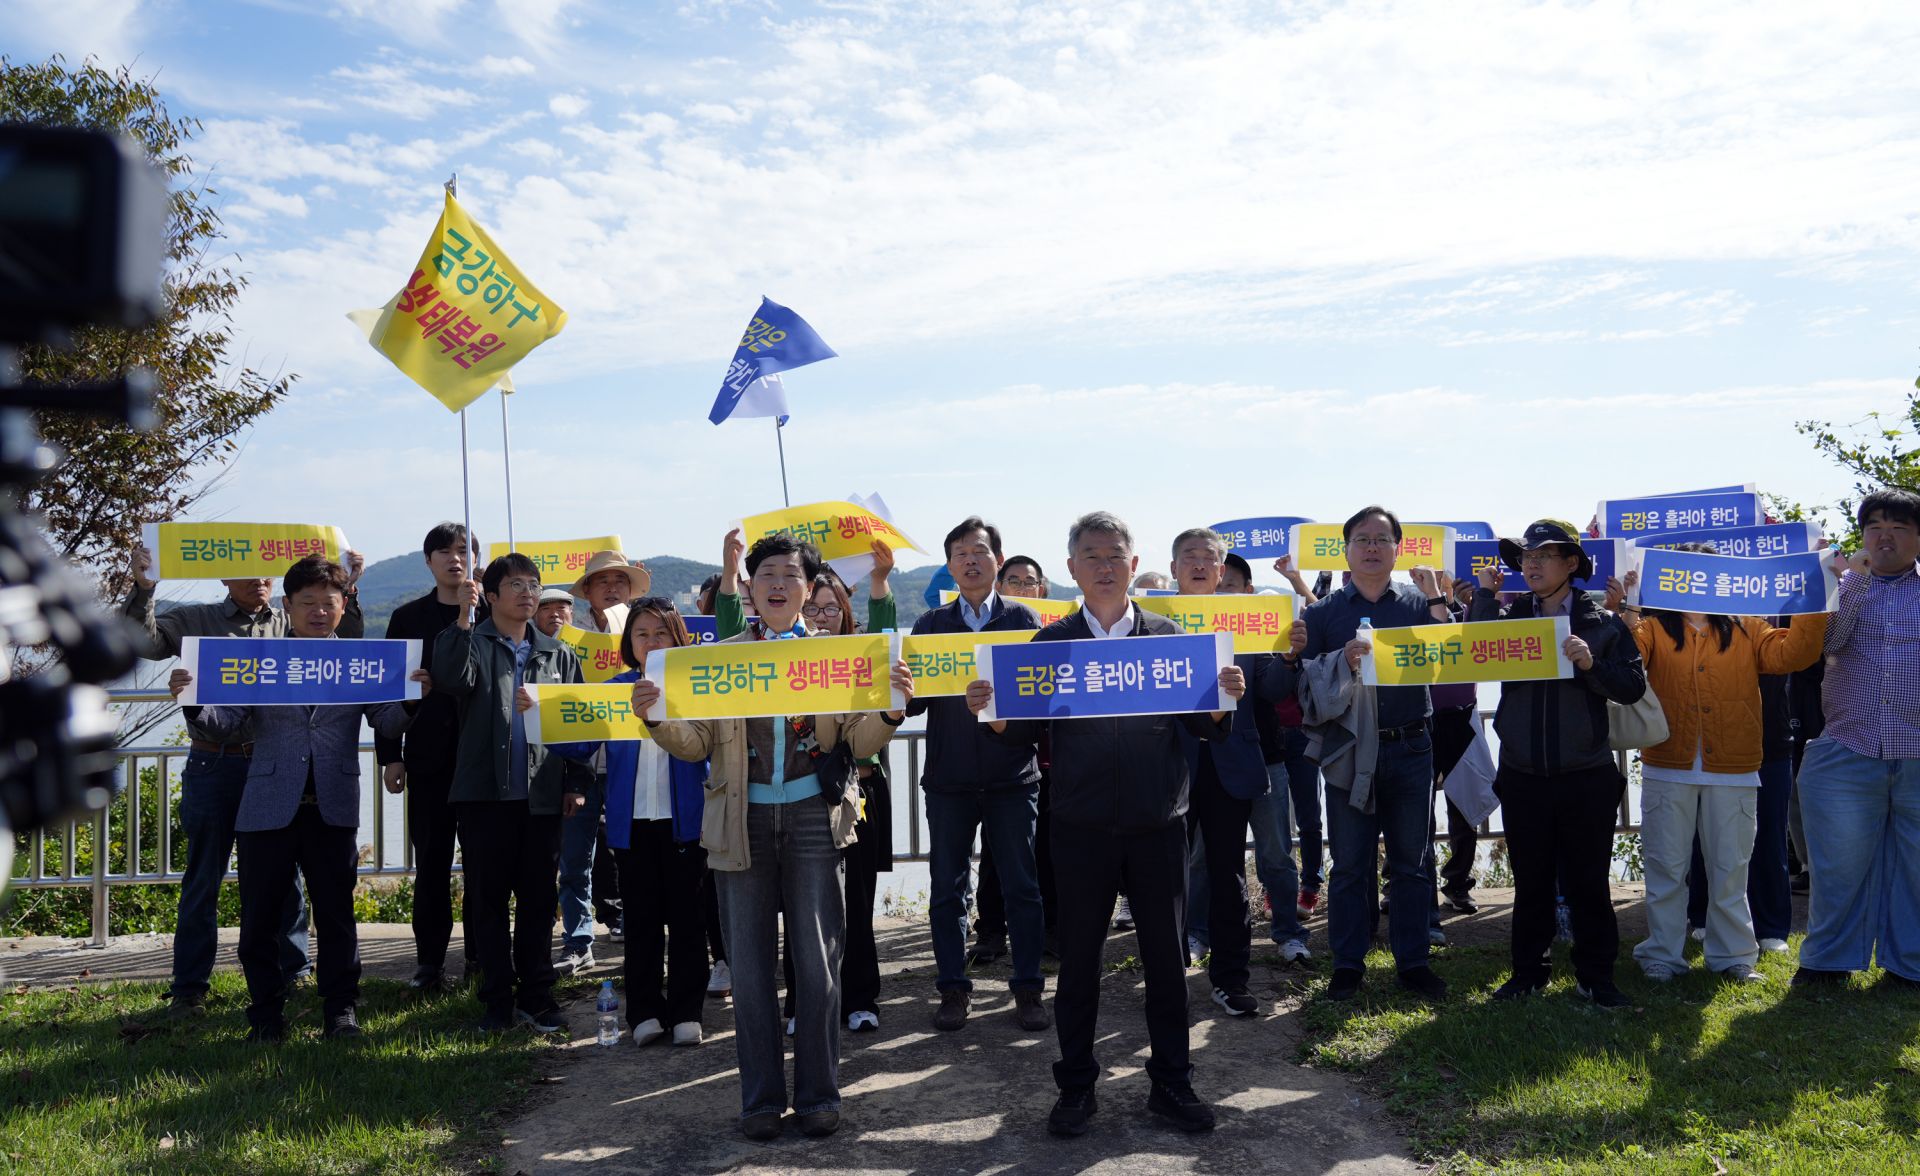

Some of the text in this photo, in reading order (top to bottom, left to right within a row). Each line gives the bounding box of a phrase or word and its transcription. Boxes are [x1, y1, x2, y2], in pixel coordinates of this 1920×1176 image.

[432, 228, 541, 328] 금강하구
[396, 268, 506, 369] 생태복원
[1620, 506, 1739, 531] 금강은 흘러야 한다
[180, 538, 326, 561] 금강하구 생태복원
[1250, 528, 1286, 547] 흘러야
[1313, 537, 1433, 557] 금강 복원
[1756, 534, 1789, 556] 한다
[531, 553, 560, 572] 하구
[1658, 567, 1807, 598] 금강은 흘러야 한다
[1211, 611, 1279, 636] 생태복원
[594, 648, 623, 671] 생태
[907, 651, 976, 678] 금강하구
[1392, 636, 1543, 668] 금강하구 생태복원
[220, 657, 385, 685] 금강은 흘러야 한다
[689, 656, 873, 695] 금강하구 생태복원
[1015, 657, 1193, 696] 금강은 흘러야 한다
[560, 701, 632, 723] 금강하구
